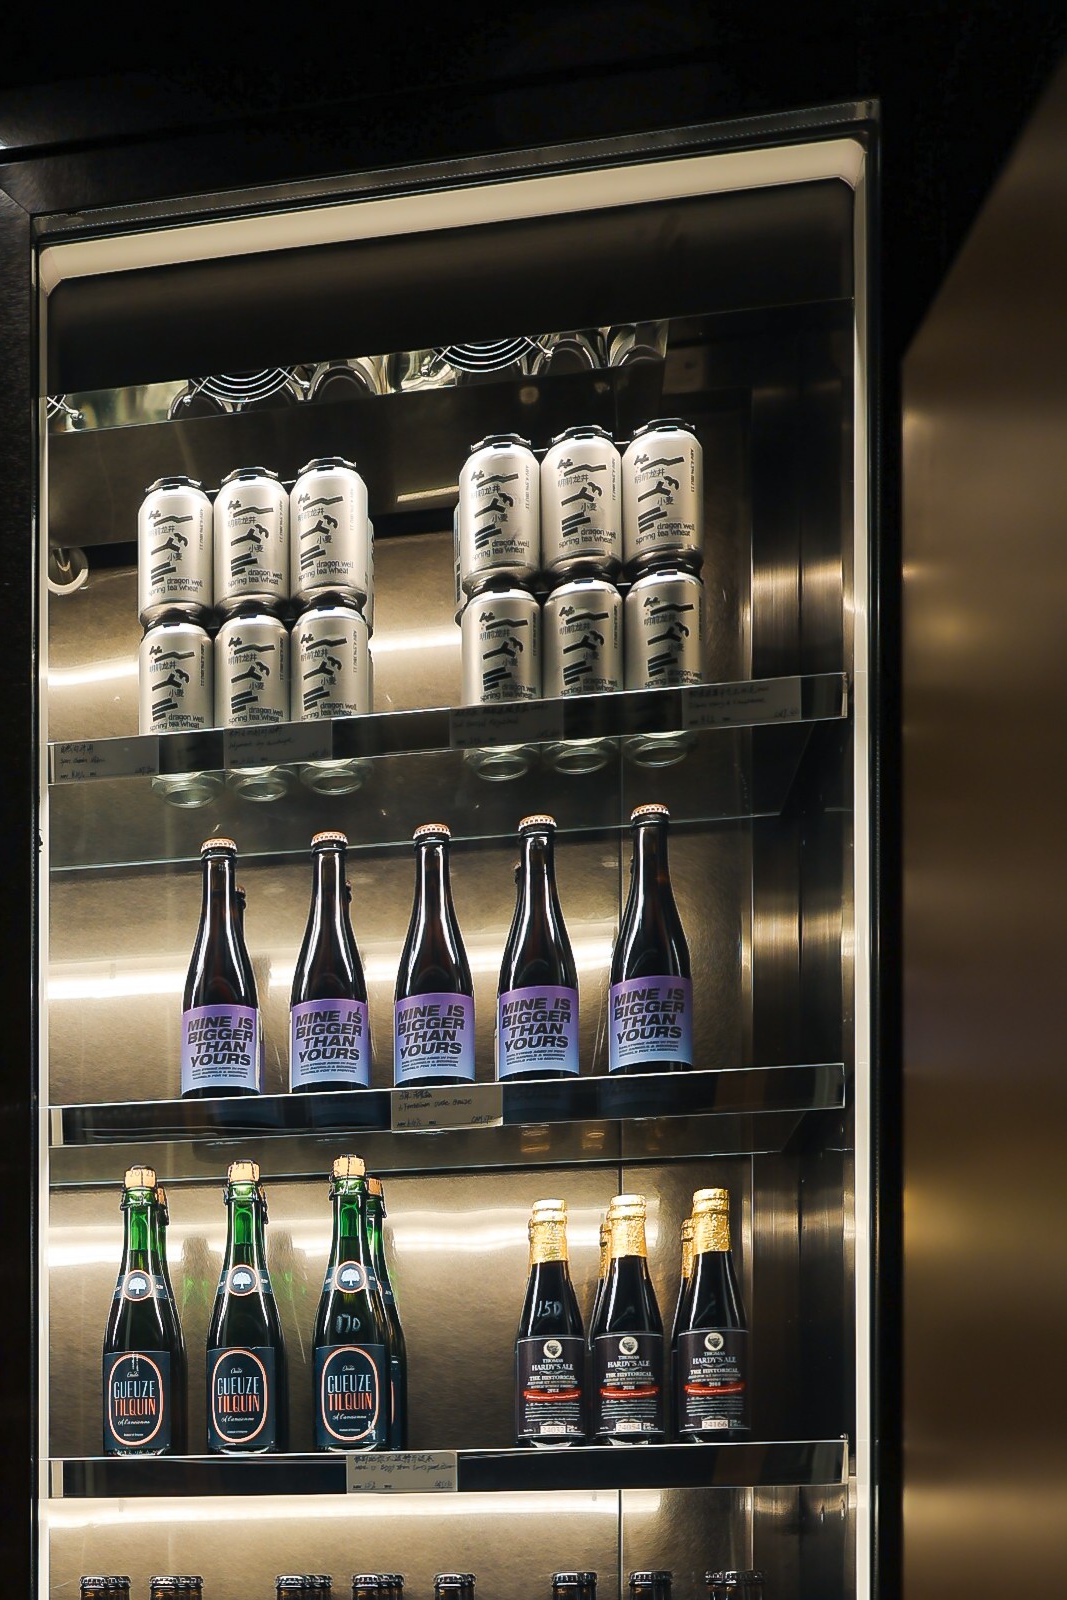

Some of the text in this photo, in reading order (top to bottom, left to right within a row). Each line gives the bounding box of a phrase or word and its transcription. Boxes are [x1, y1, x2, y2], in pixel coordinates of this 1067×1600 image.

[581, 503, 597, 512] 小麦
[657, 497, 673, 505] 小麦
[657, 523, 681, 531] dragon
[636, 533, 656, 544] spring
[670, 529, 691, 537] wheat
[614, 988, 684, 1006] MINE IS
[398, 1005, 464, 1022] MINE IS
[614, 1001, 684, 1021] BIGGER
[188, 1016, 253, 1031] MINE IS
[398, 1017, 464, 1036] BIGGER
[621, 1014, 676, 1029] THAN
[188, 1029, 253, 1045] BIGGER
[404, 1029, 456, 1045] THAN
[617, 1026, 682, 1044] YOURS
[196, 1042, 246, 1055] THAN
[400, 1043, 462, 1059] YOURS
[191, 1054, 251, 1067] YOURS
[537, 1301, 561, 1318] 150
[114, 1381, 155, 1399] GUEUZE
[217, 1377, 259, 1395] GUEUZE
[327, 1375, 371, 1393] GUEUZE
[114, 1396, 156, 1416] TILQUIN
[217, 1394, 260, 1412] TILQUIN
[328, 1392, 372, 1411] TILQUIN
